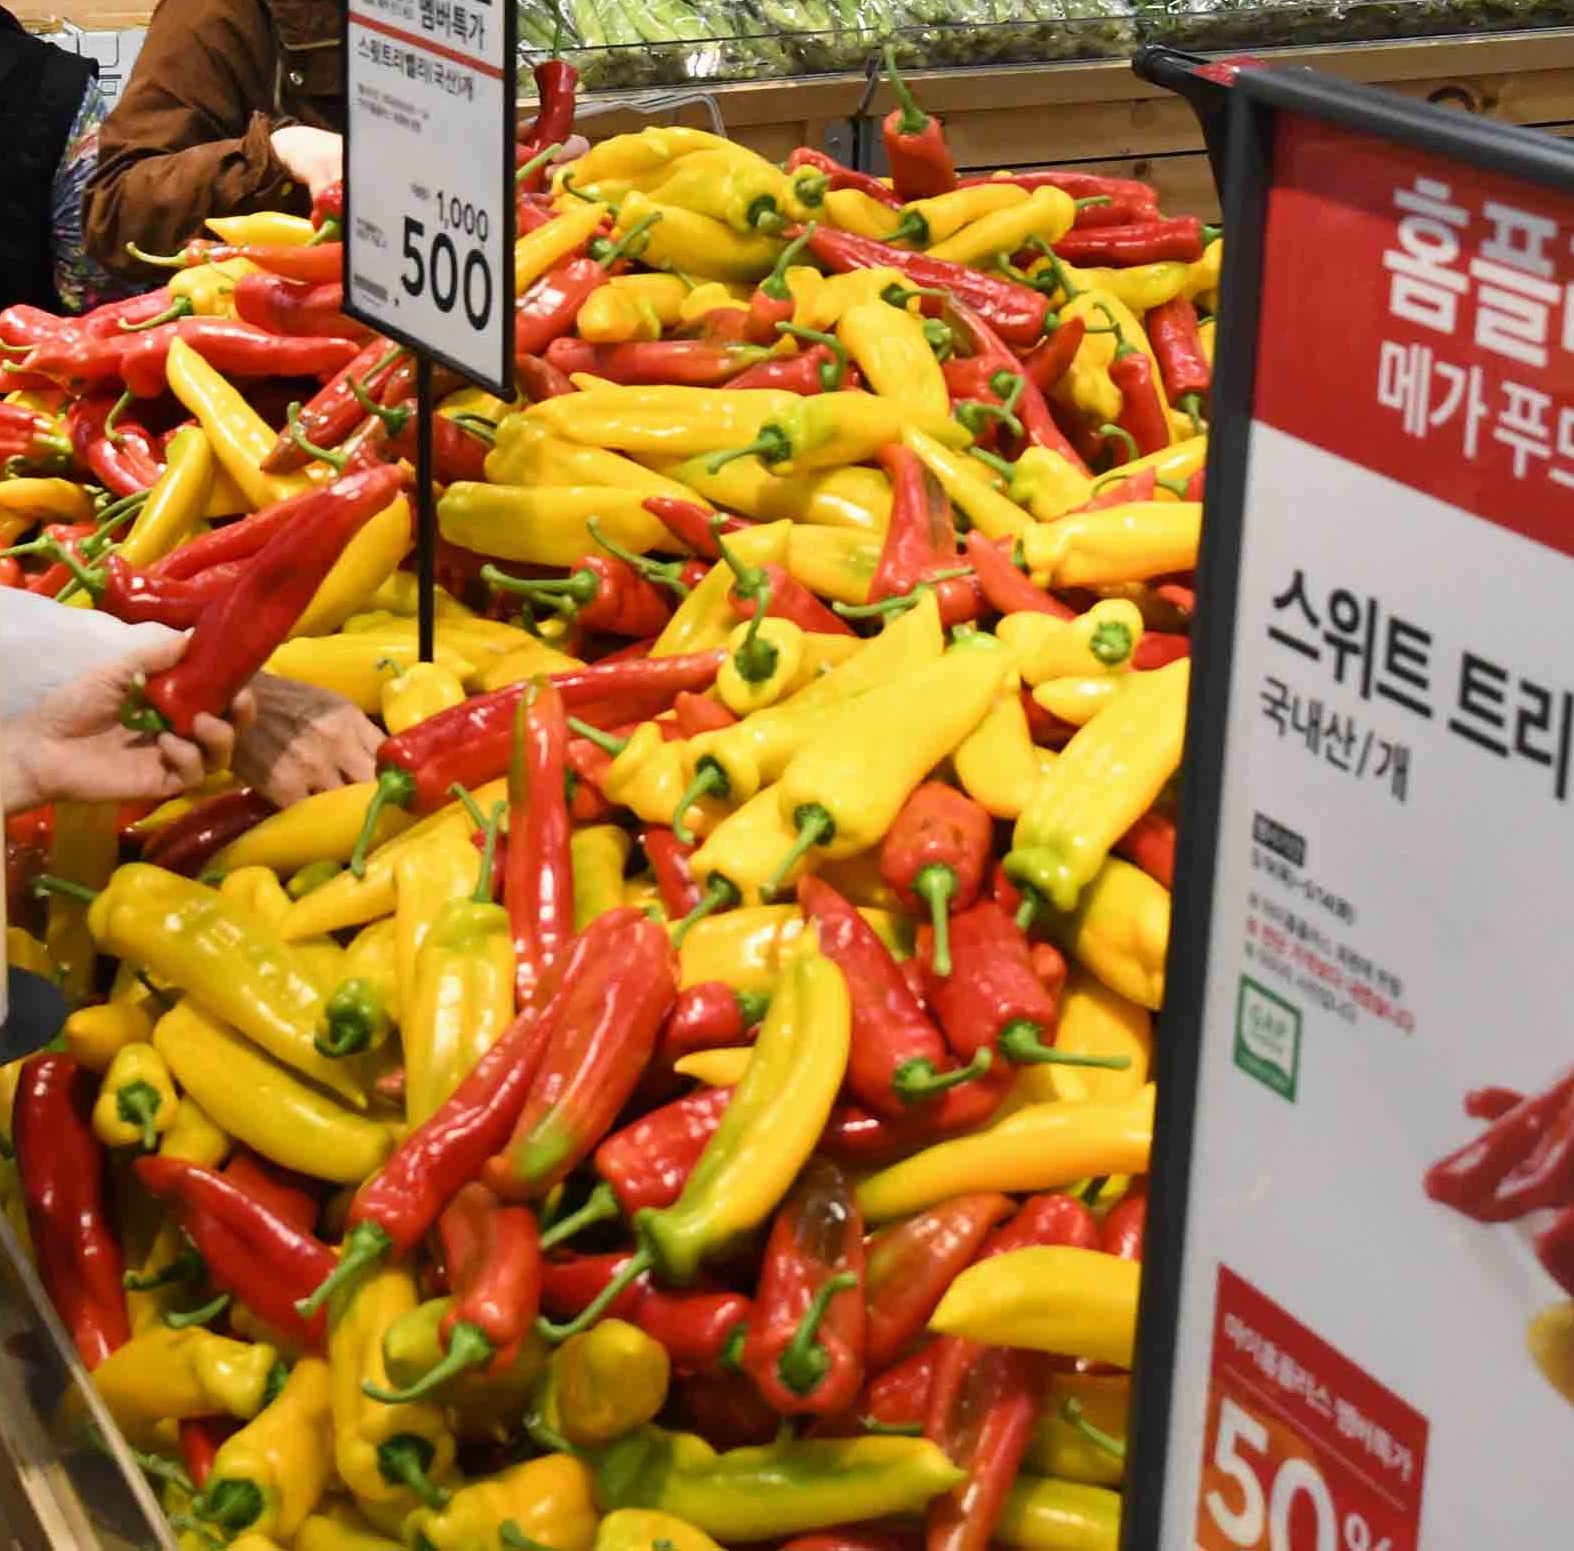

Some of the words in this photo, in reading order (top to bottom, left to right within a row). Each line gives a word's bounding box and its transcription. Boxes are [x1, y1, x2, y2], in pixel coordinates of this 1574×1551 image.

[400, 215, 493, 332] 500
[436, 189, 489, 243] 1,000
[1375, 337, 1487, 458] 메가
[1266, 566, 1434, 722] 스위트
[1258, 676, 1413, 807] 국내산/개
